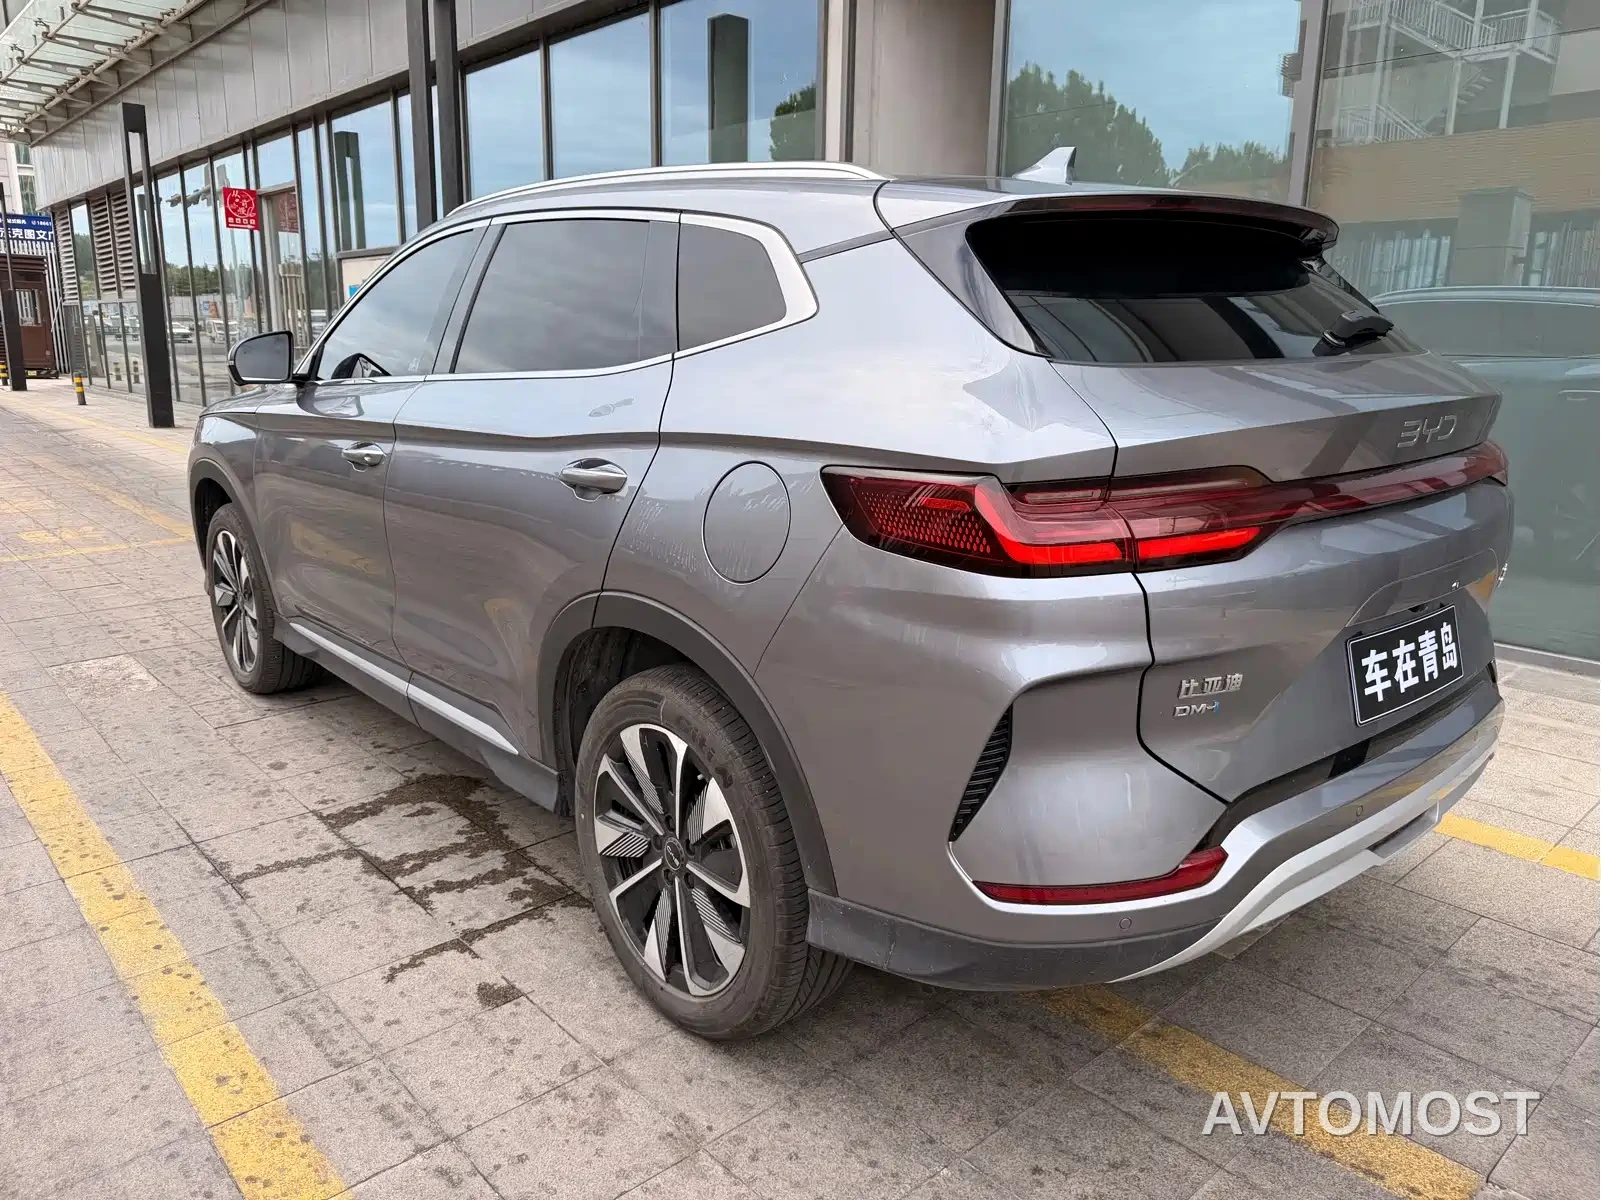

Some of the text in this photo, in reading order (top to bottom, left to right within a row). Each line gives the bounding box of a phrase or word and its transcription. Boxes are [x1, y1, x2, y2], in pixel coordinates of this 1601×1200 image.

[1397, 414, 1457, 448] BYD
[1361, 621, 1458, 703] 车在青岛
[1178, 673, 1243, 699] 比亚迪
